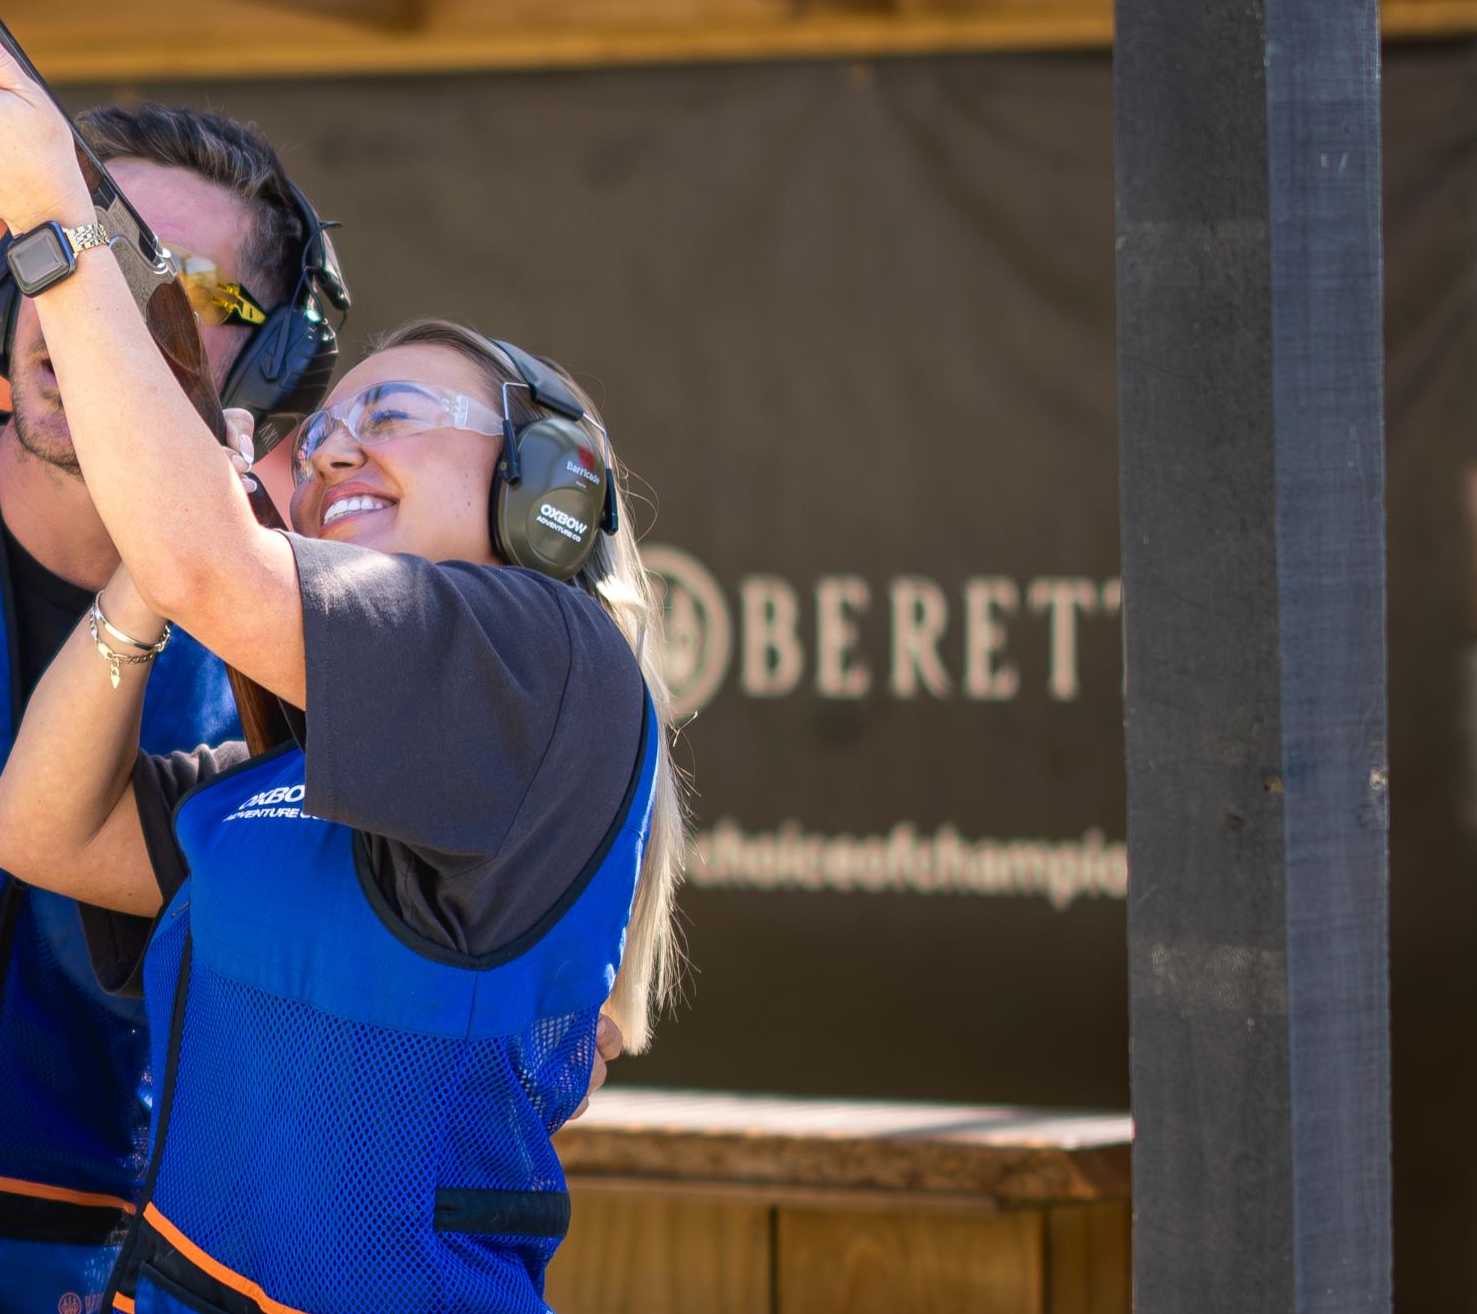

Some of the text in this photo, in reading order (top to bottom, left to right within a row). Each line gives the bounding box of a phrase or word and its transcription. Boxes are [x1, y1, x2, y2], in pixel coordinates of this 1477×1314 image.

[536, 515, 573, 539] ADVENTURE
[540, 504, 588, 535] OXBOW
[741, 573, 1123, 698] BERET
[238, 784, 306, 811] OXBO
